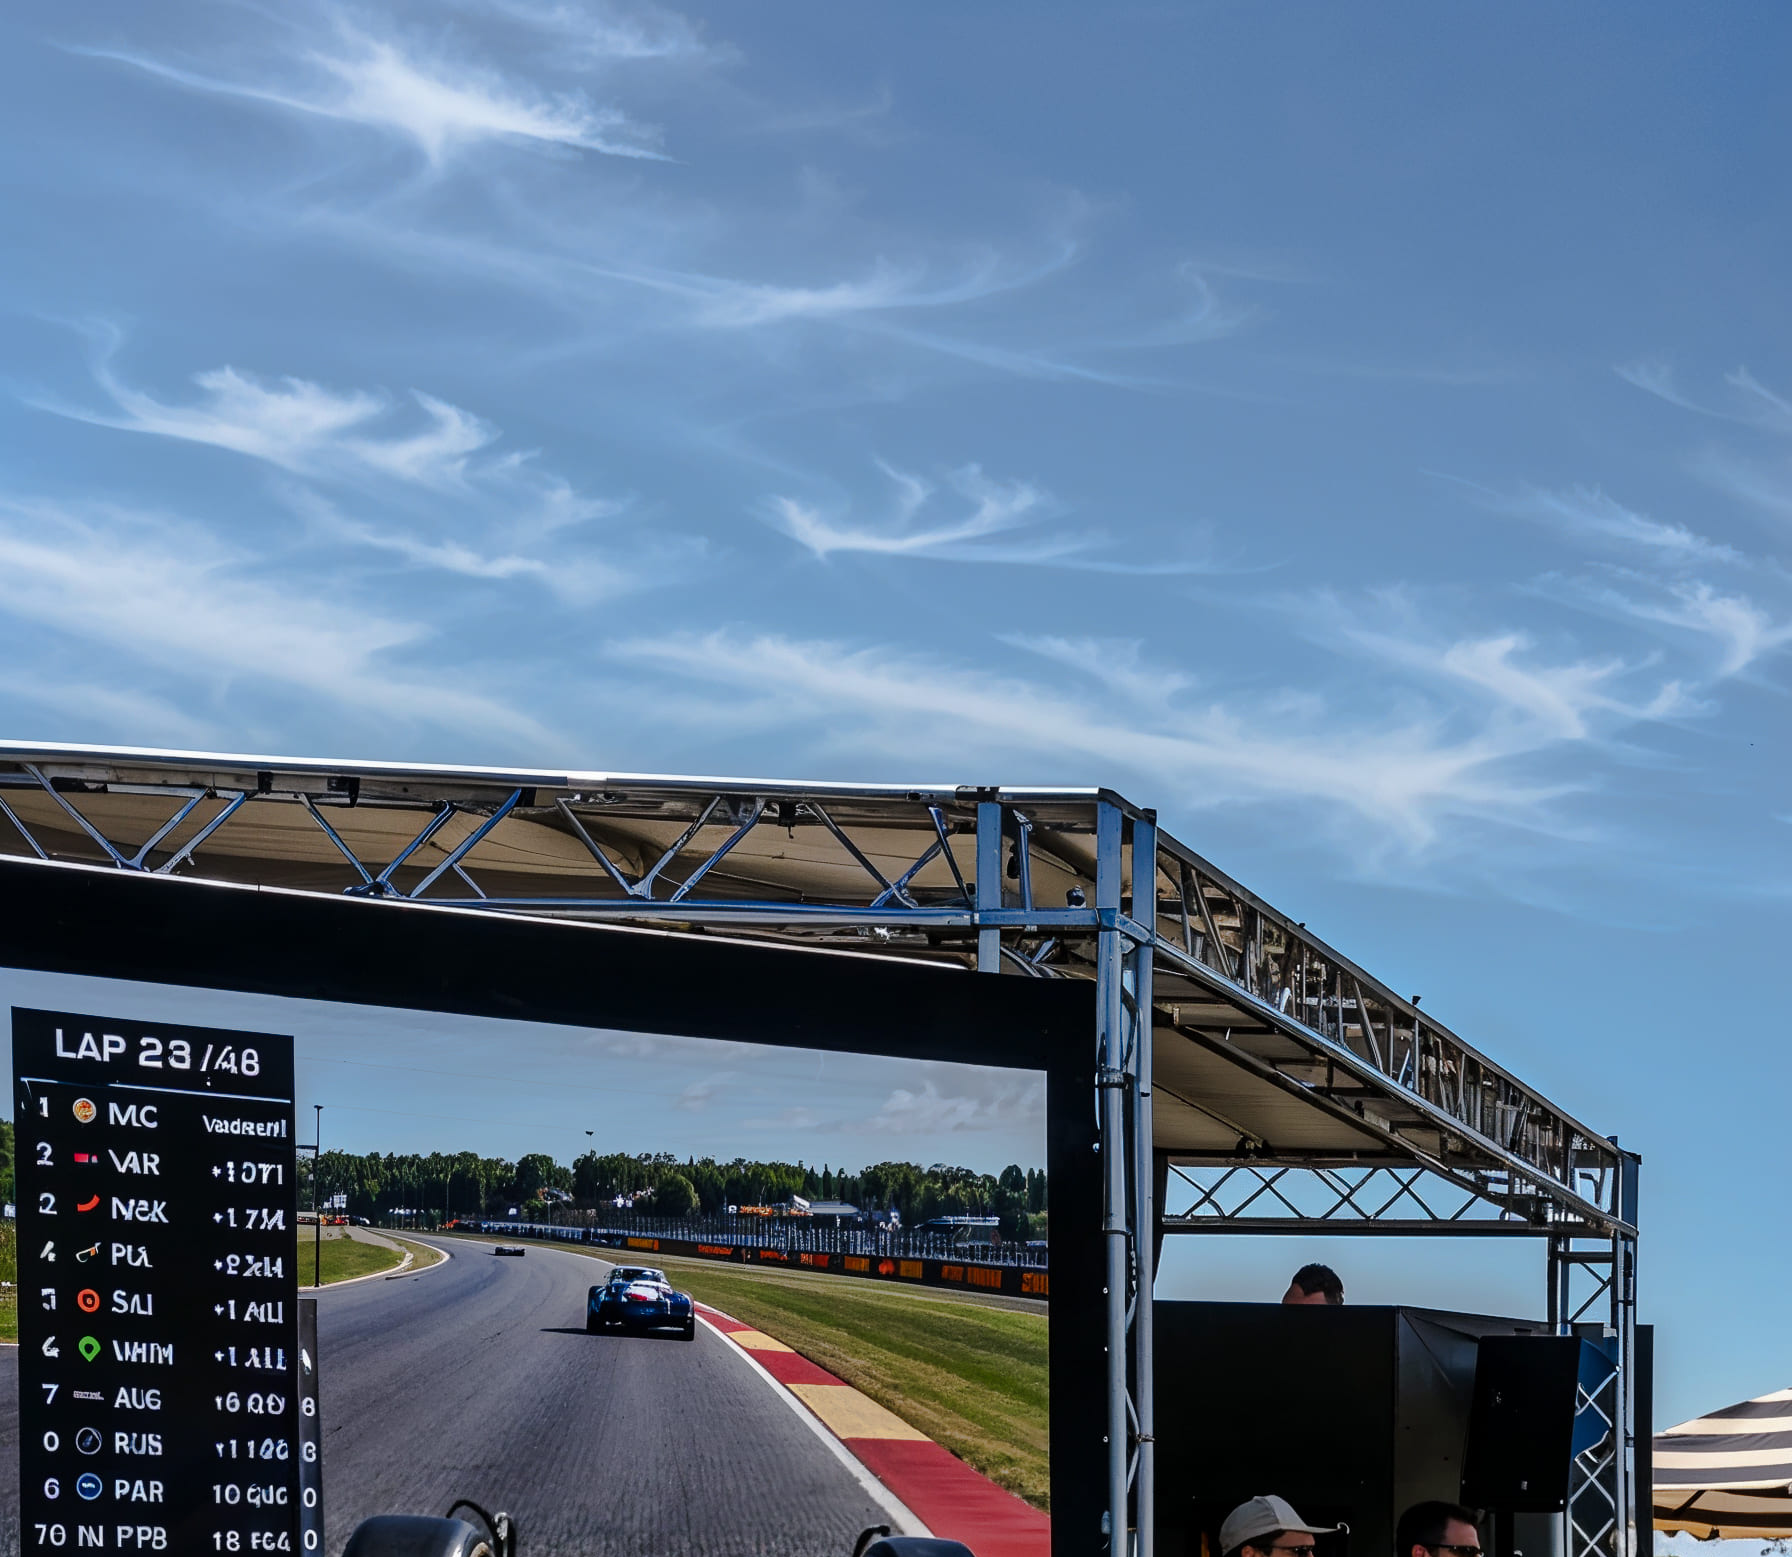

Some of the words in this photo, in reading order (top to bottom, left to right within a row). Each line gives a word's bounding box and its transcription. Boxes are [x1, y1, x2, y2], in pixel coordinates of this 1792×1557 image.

[56, 1029, 126, 1062] LAP
[42, 1384, 59, 1404] 7
[115, 1432, 162, 1455] RUS
[115, 1480, 163, 1502] PAR
